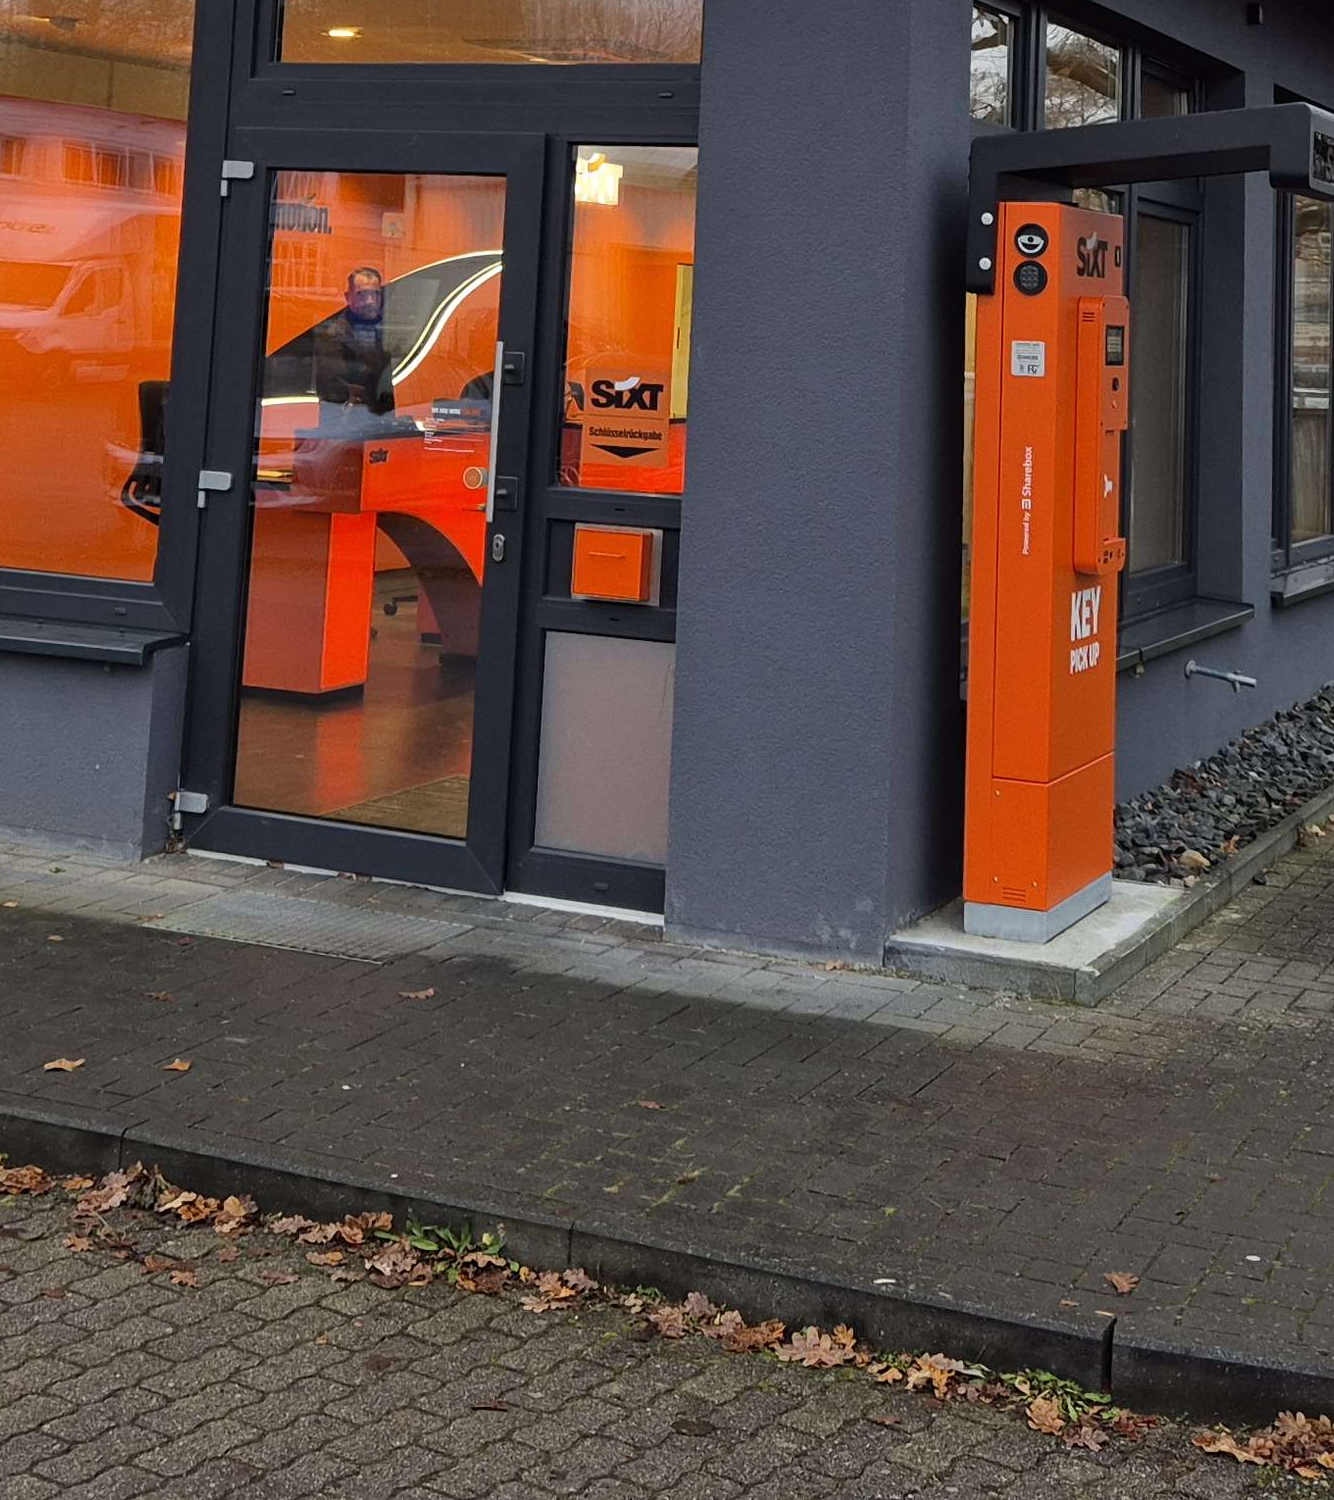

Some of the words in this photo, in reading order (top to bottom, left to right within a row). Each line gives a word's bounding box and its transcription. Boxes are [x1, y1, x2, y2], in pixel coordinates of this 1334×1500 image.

[589, 426, 663, 441] Schlüsselrückgabe
[1021, 446, 1033, 497] Sharebox
[1022, 510, 1032, 522] by
[1070, 585, 1102, 642] KEY
[1069, 644, 1088, 676] PICK
[1088, 641, 1100, 668] UP
